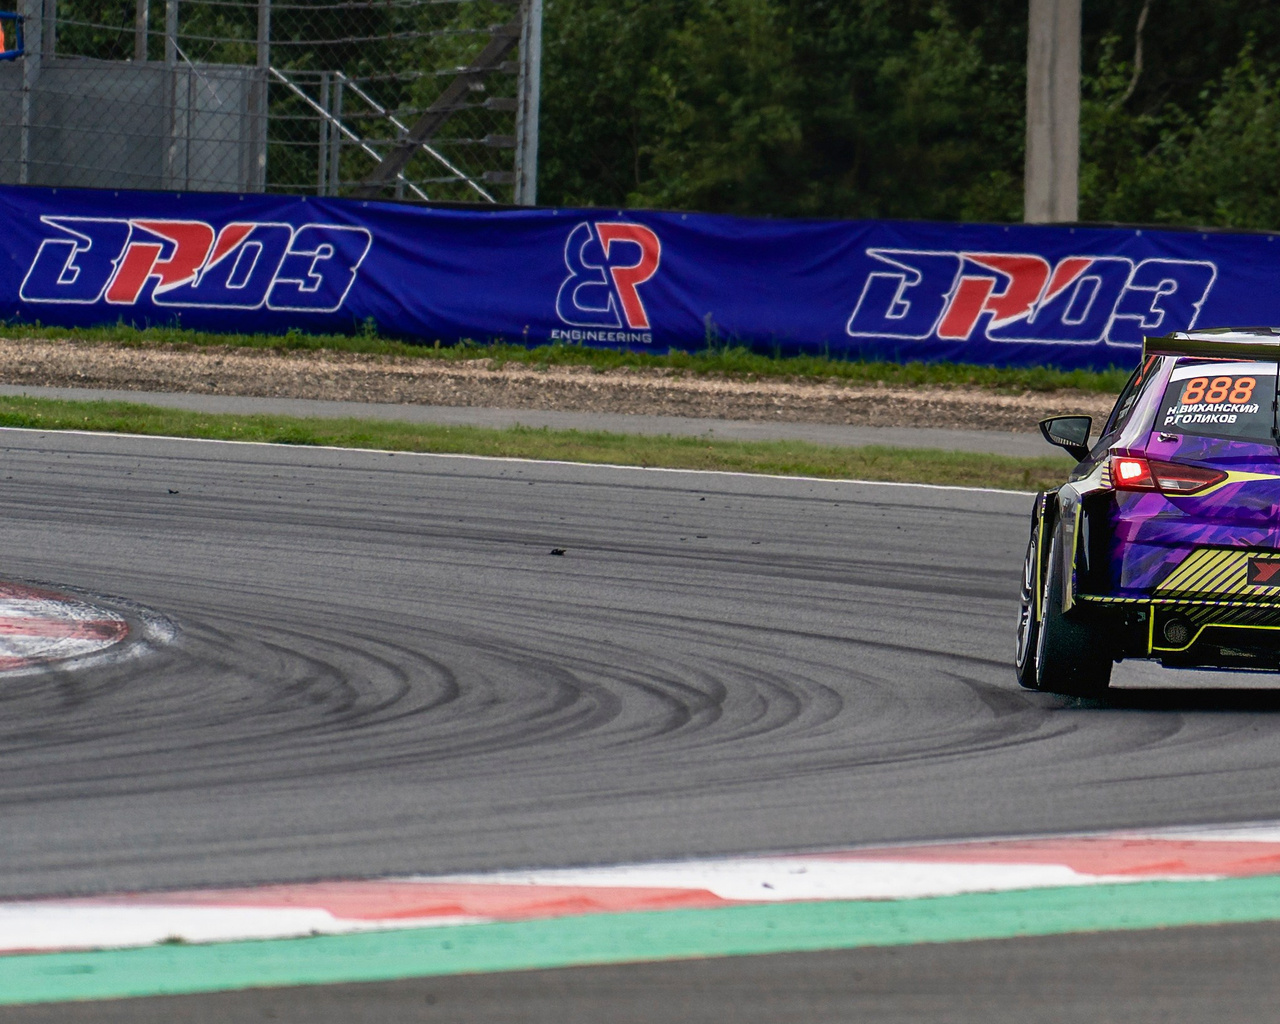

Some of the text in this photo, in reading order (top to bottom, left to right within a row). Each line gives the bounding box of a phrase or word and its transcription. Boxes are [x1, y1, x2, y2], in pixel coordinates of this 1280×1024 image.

[551, 329, 653, 344] ENGINEERING
[1181, 376, 1257, 405] 888
[1164, 413, 1238, 426] Р.ГОЛИКОВ
